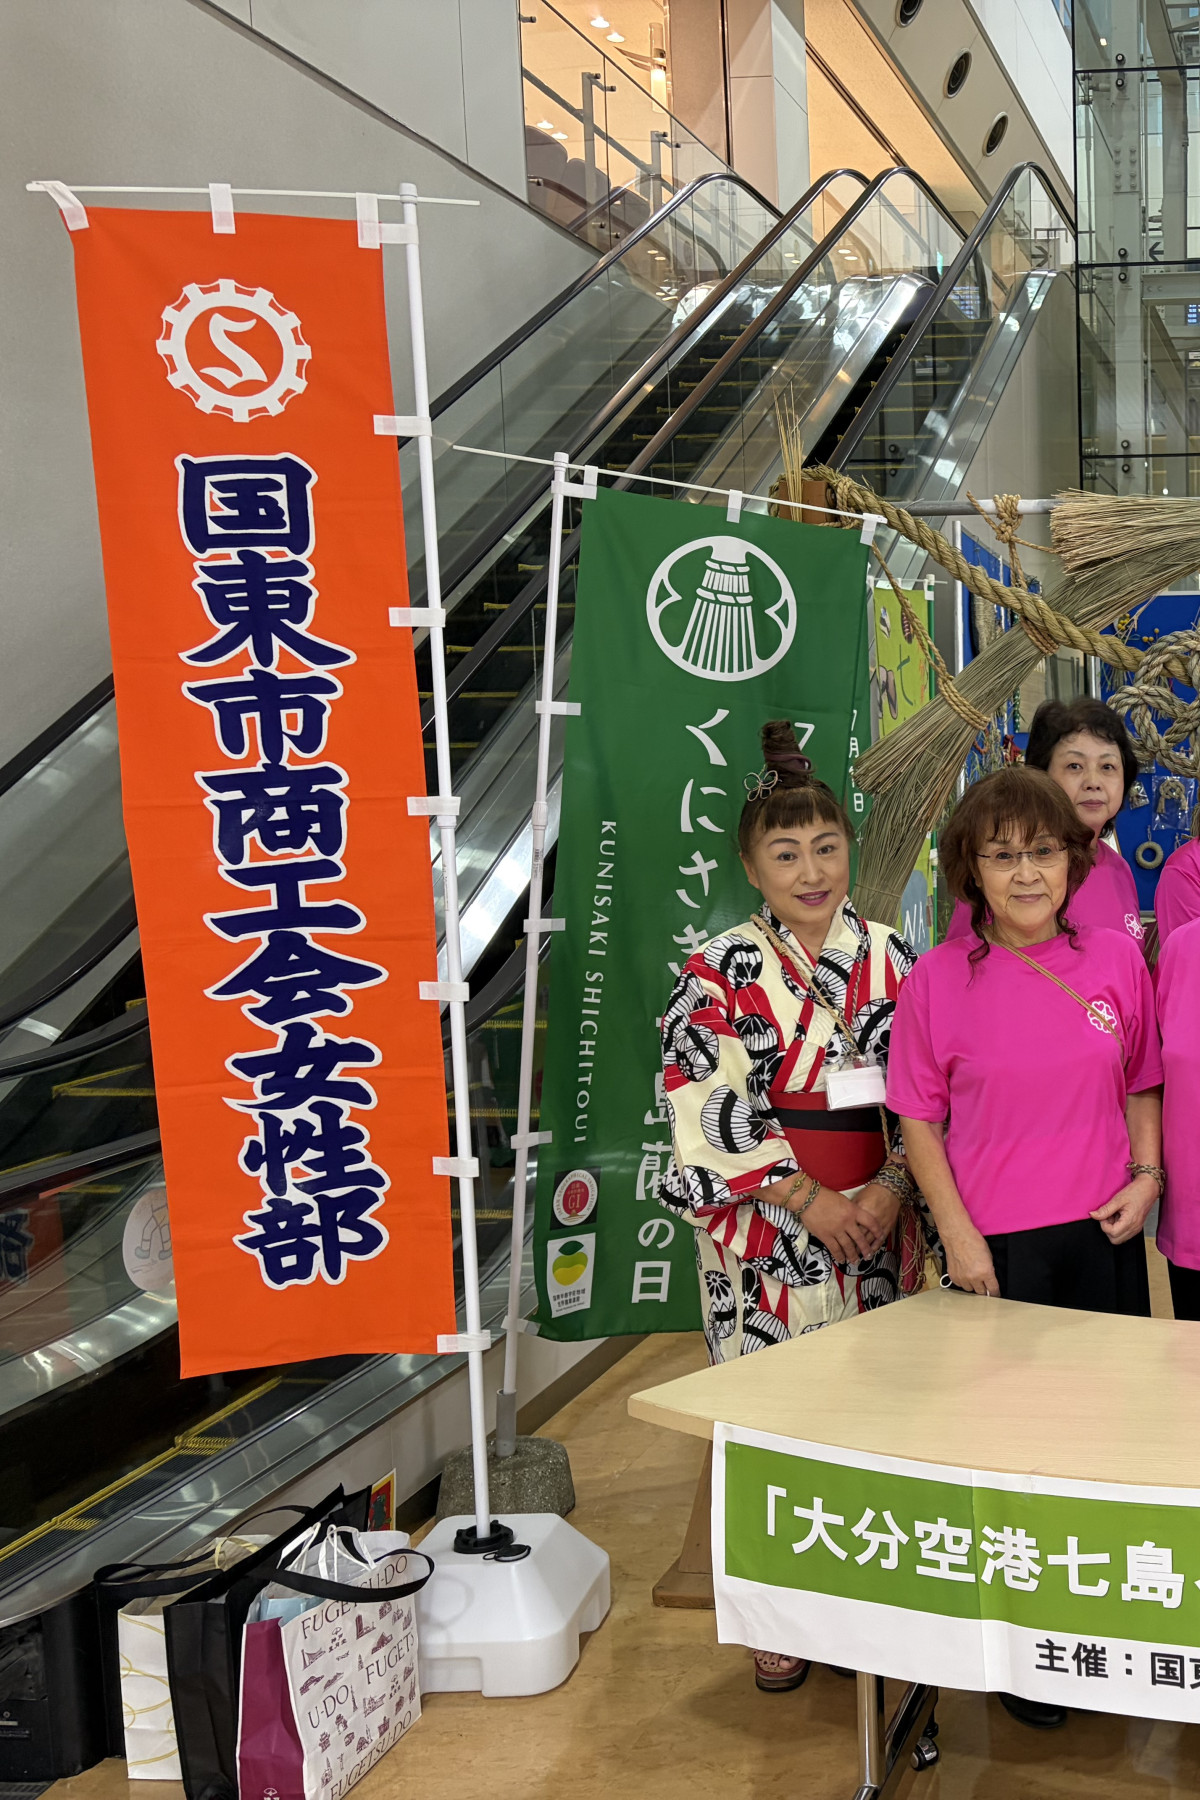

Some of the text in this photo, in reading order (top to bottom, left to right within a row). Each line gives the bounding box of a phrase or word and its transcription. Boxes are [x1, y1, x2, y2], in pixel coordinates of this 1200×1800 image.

[175, 453, 390, 1290] 国東市商工会女性部
[573, 820, 617, 1144] KUNISAKI SHICHITOUI
[568, 1194, 581, 1209] GI
